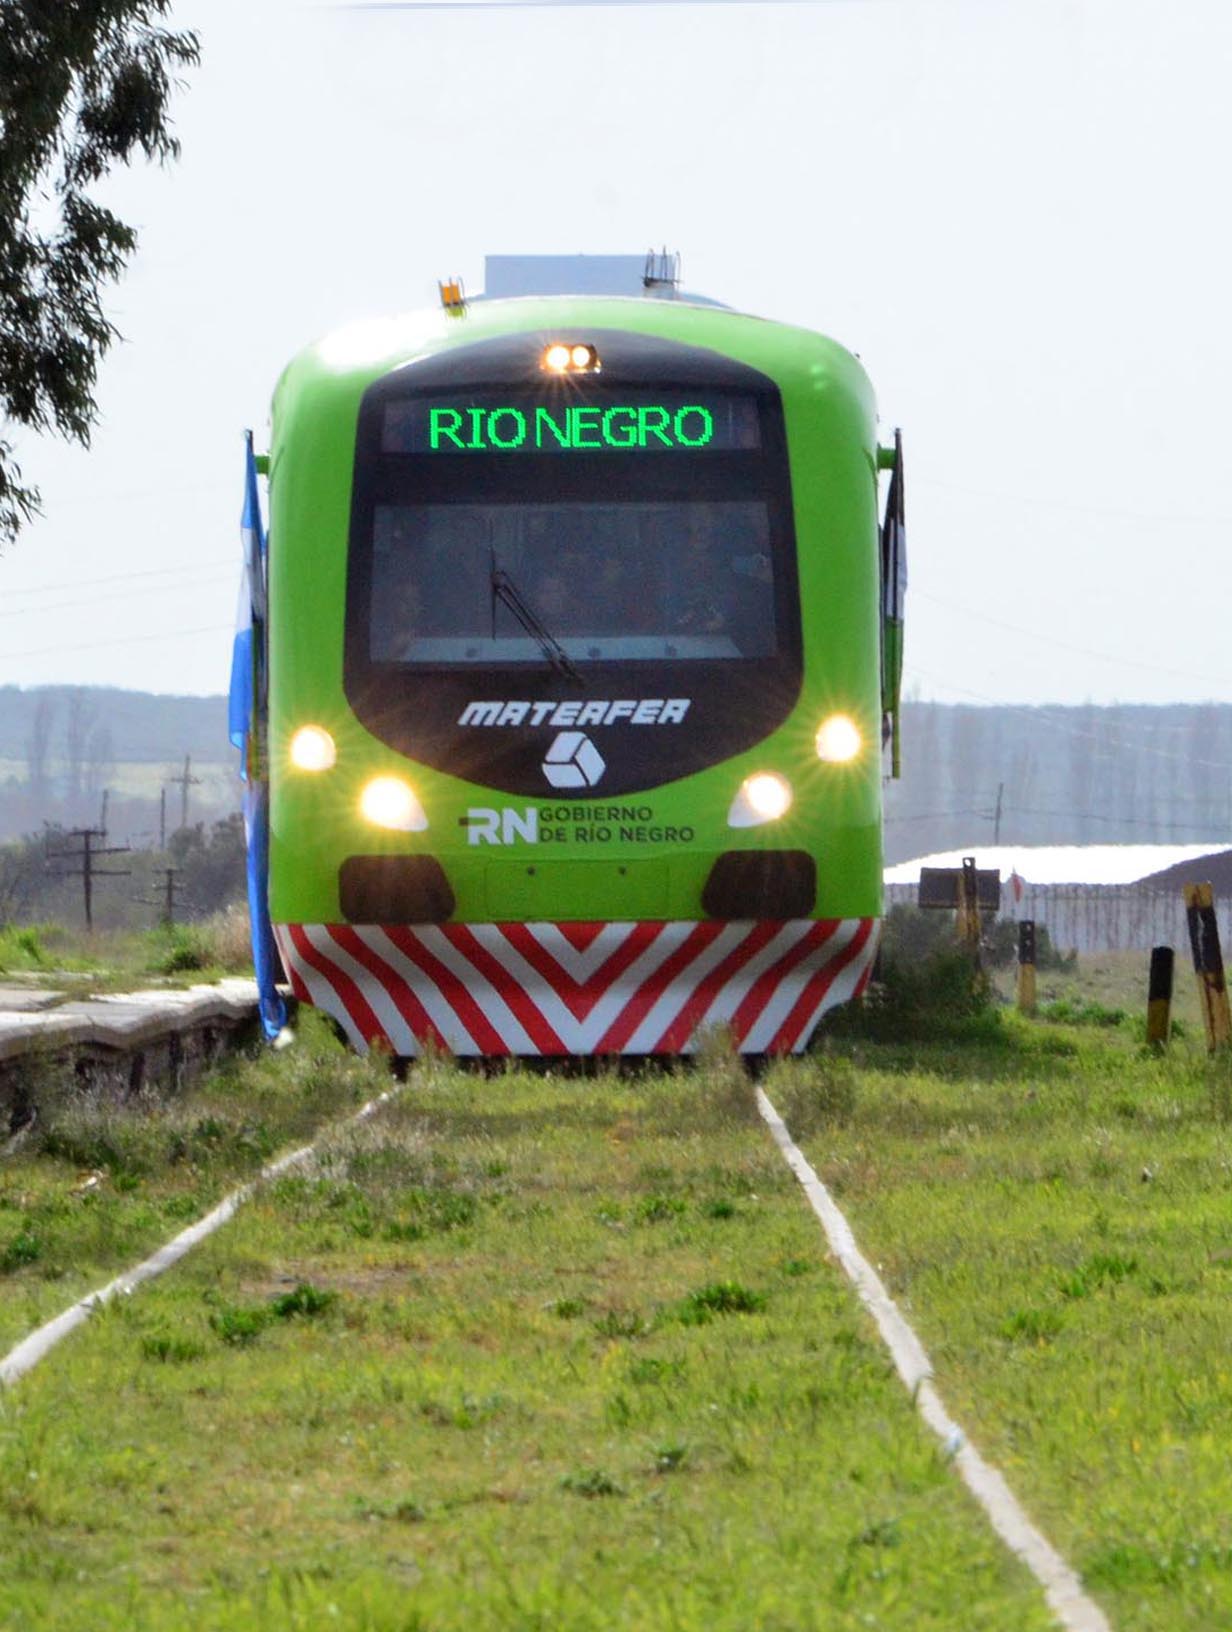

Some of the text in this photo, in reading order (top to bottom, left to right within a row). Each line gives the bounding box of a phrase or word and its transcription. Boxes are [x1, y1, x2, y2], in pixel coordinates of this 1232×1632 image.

[429, 405, 713, 449] RIO NEGRO
[457, 698, 692, 727] MATERFER
[466, 807, 538, 846] RN
[539, 806, 653, 822] GOBIERNO
[539, 823, 695, 843] DE RÍO NEGRO
